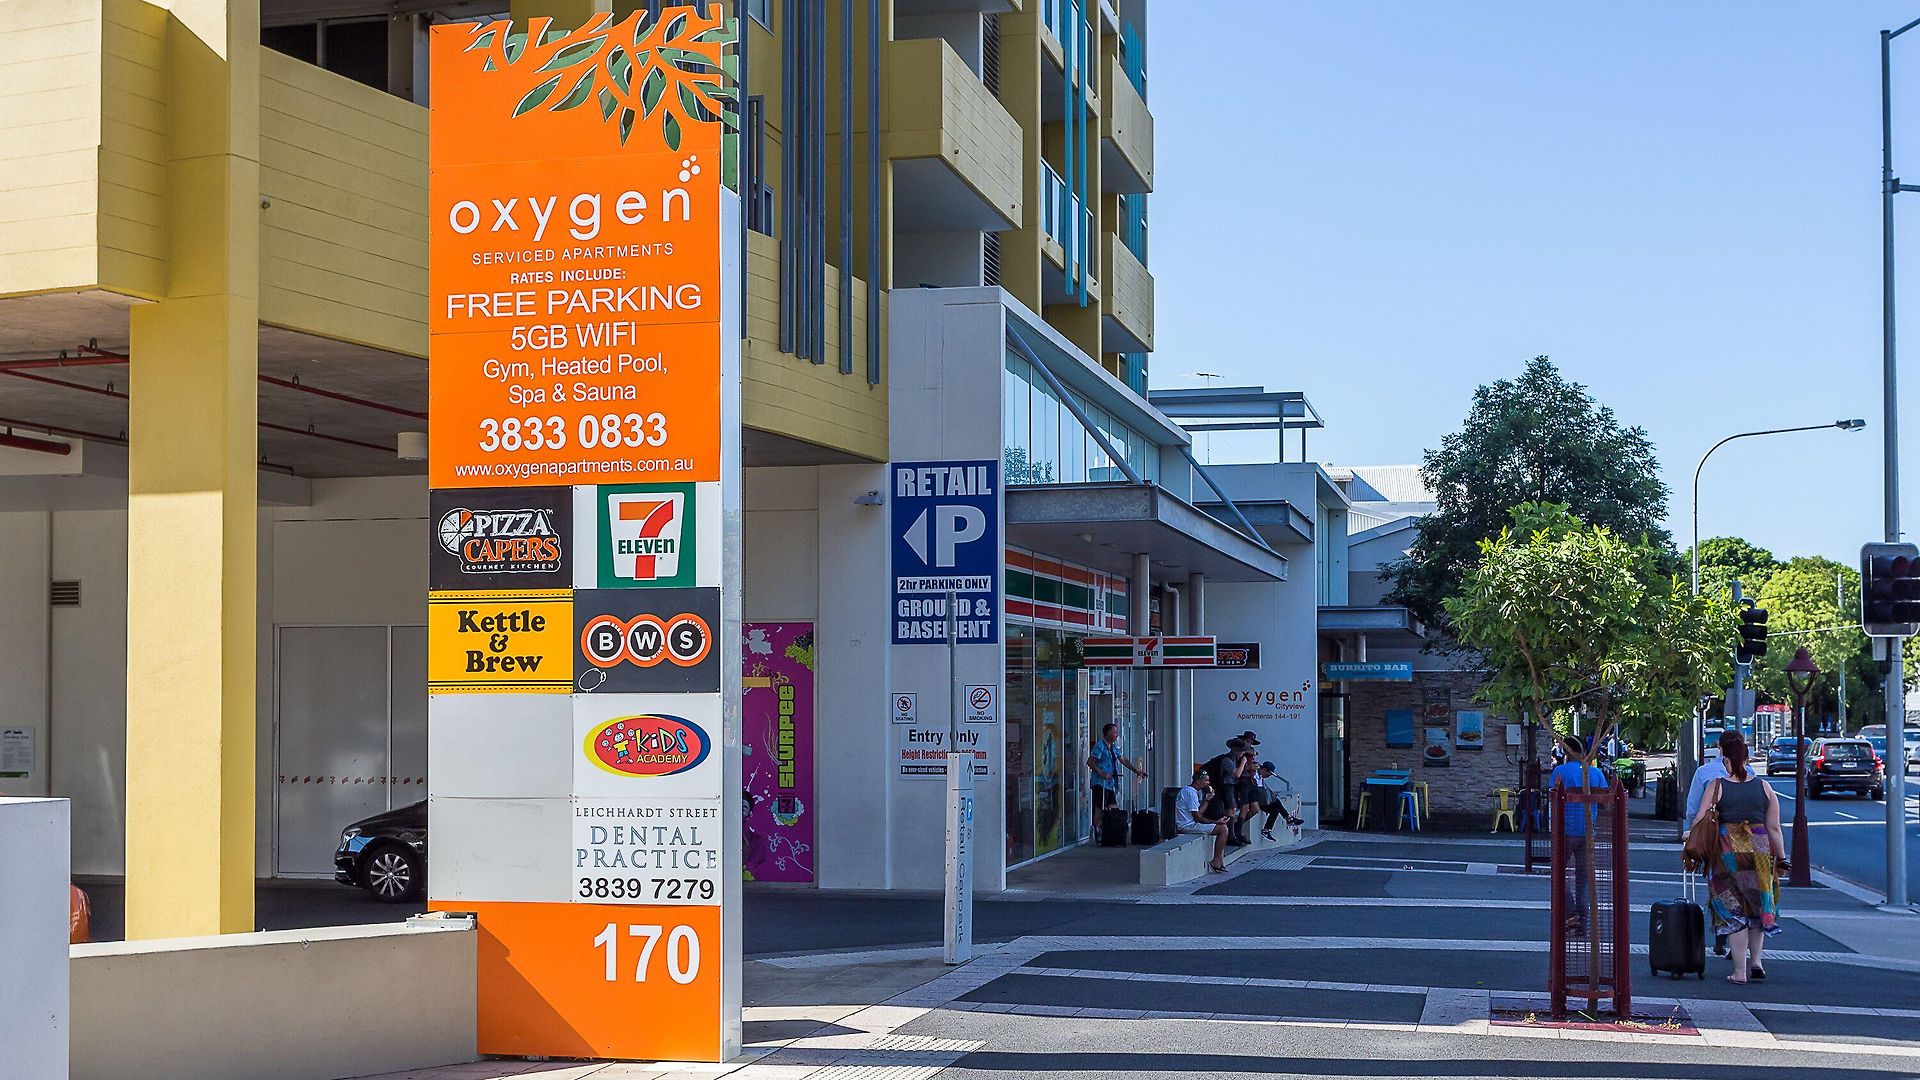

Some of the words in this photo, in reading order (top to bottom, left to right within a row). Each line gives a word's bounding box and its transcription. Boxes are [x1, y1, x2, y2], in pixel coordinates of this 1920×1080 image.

[449, 187, 690, 242] oxygen
[472, 249, 555, 265] SERVICED
[562, 243, 674, 261] APARTMENTS
[510, 271, 554, 284] RATES
[560, 268, 626, 282] INCLUDE:
[447, 291, 536, 319] FREE
[548, 284, 702, 315] PARKING
[511, 324, 568, 351] 5GB
[576, 321, 636, 348] WIFI
[483, 358, 535, 382] Gym,
[541, 354, 611, 377] Heated
[618, 352, 668, 374] Pool,
[508, 384, 545, 408] Spa
[551, 383, 566, 402] &
[572, 382, 636, 401] Sauna
[479, 415, 567, 452] 3833
[578, 412, 668, 449] 0833
[455, 457, 694, 479] www.oxygenapartments.com.au
[897, 466, 992, 497] RETAIL
[473, 512, 551, 537] PIZZA
[936, 505, 986, 567] P
[464, 537, 559, 563] CAPERS
[618, 499, 674, 579] 7
[899, 579, 918, 591] 2hr
[919, 579, 963, 591] PARKING
[964, 578, 989, 590] ONLY
[898, 599, 971, 617] GROUD
[975, 598, 991, 617] &
[458, 610, 545, 633] Kettle
[489, 633, 509, 653] &
[1138, 638, 1158, 665] 7
[465, 650, 543, 673] Brew
[1228, 691, 1302, 705] oxygen
[908, 728, 943, 746] Entry
[636, 754, 688, 764] ACADEMY
[901, 749, 921, 761] Height
[576, 807, 663, 818] LEICHHARDT
[669, 808, 718, 818] STREET
[590, 826, 703, 845] DENTAL
[576, 849, 717, 869] PRACTICE
[579, 877, 642, 899] 3839
[651, 879, 714, 899] 7279
[593, 923, 700, 984] 170
